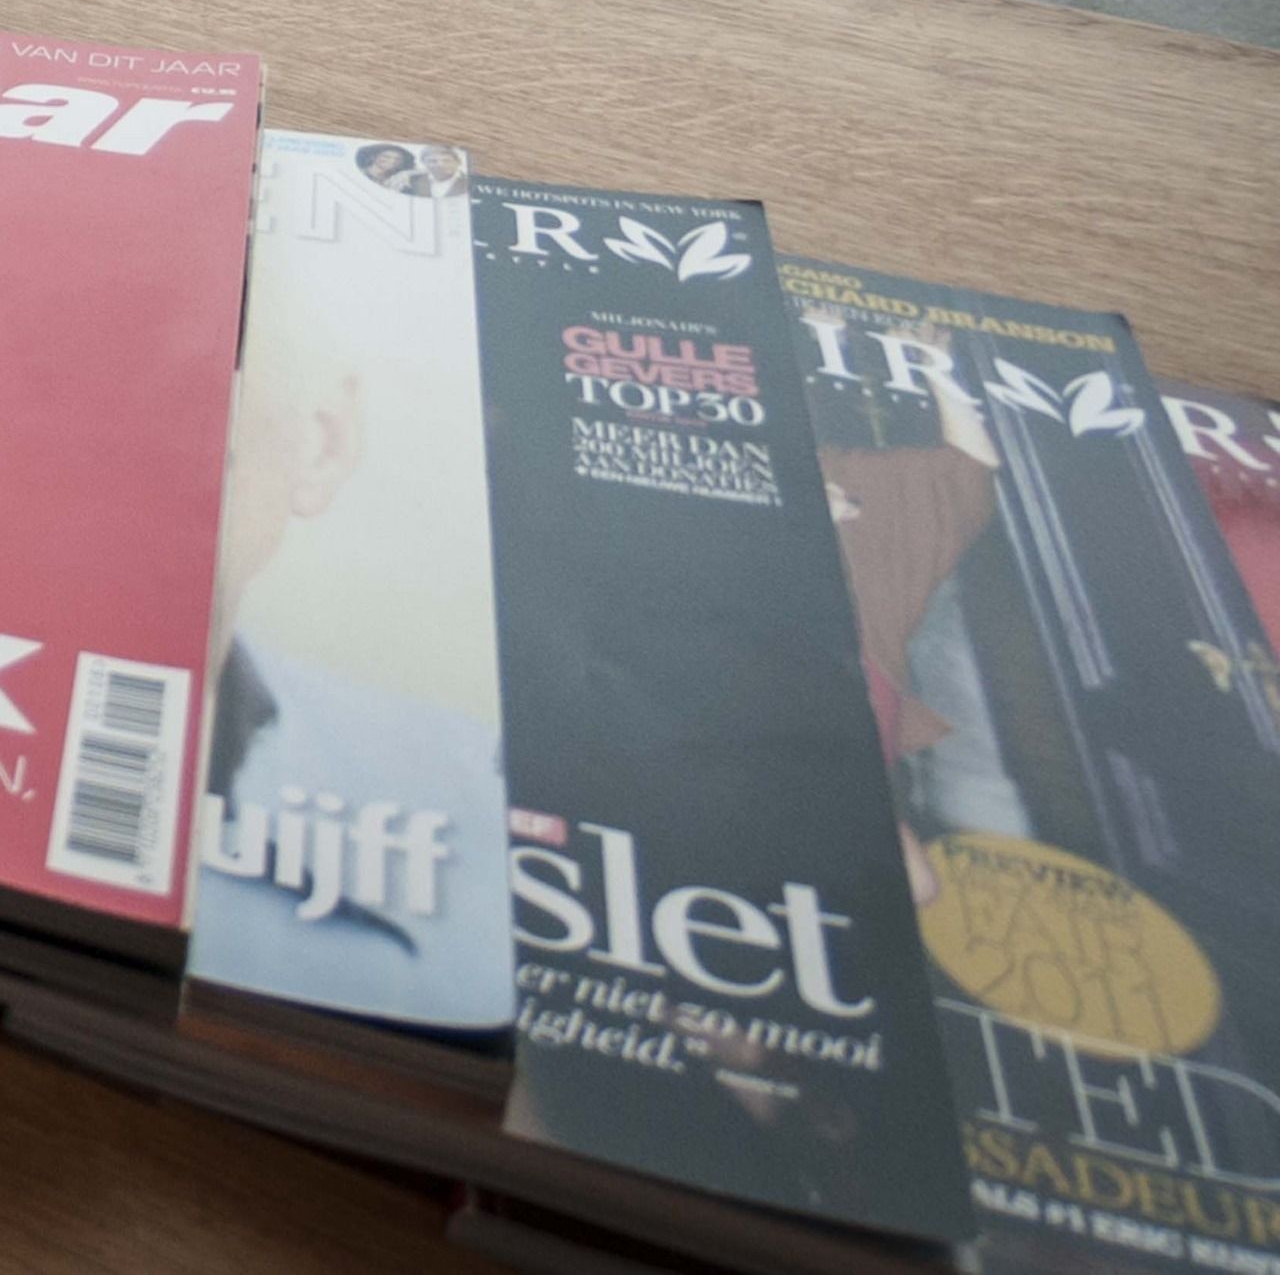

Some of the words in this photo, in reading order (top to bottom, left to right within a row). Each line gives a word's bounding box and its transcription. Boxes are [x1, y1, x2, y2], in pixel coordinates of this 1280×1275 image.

[12, 41, 80, 65] VAN
[88, 52, 144, 72] DIT
[149, 58, 241, 77] JAAR
[512, 189, 611, 209] HOTSPOTS
[614, 200, 635, 211] IN
[642, 201, 687, 215] NEW
[690, 206, 742, 220] YORK
[783, 277, 919, 318] CHARD
[926, 307, 1117, 354] BRANSON
[562, 325, 756, 374] GULLE
[799, 314, 984, 407] IR
[563, 352, 761, 398] GEVERS
[565, 372, 690, 416] TOP
[572, 416, 681, 451] MEER
[690, 434, 770, 464] DAN
[509, 821, 880, 1019] slet
[573, 972, 668, 1023] niet
[674, 1002, 737, 1038] zo
[748, 1017, 883, 1071] mooi
